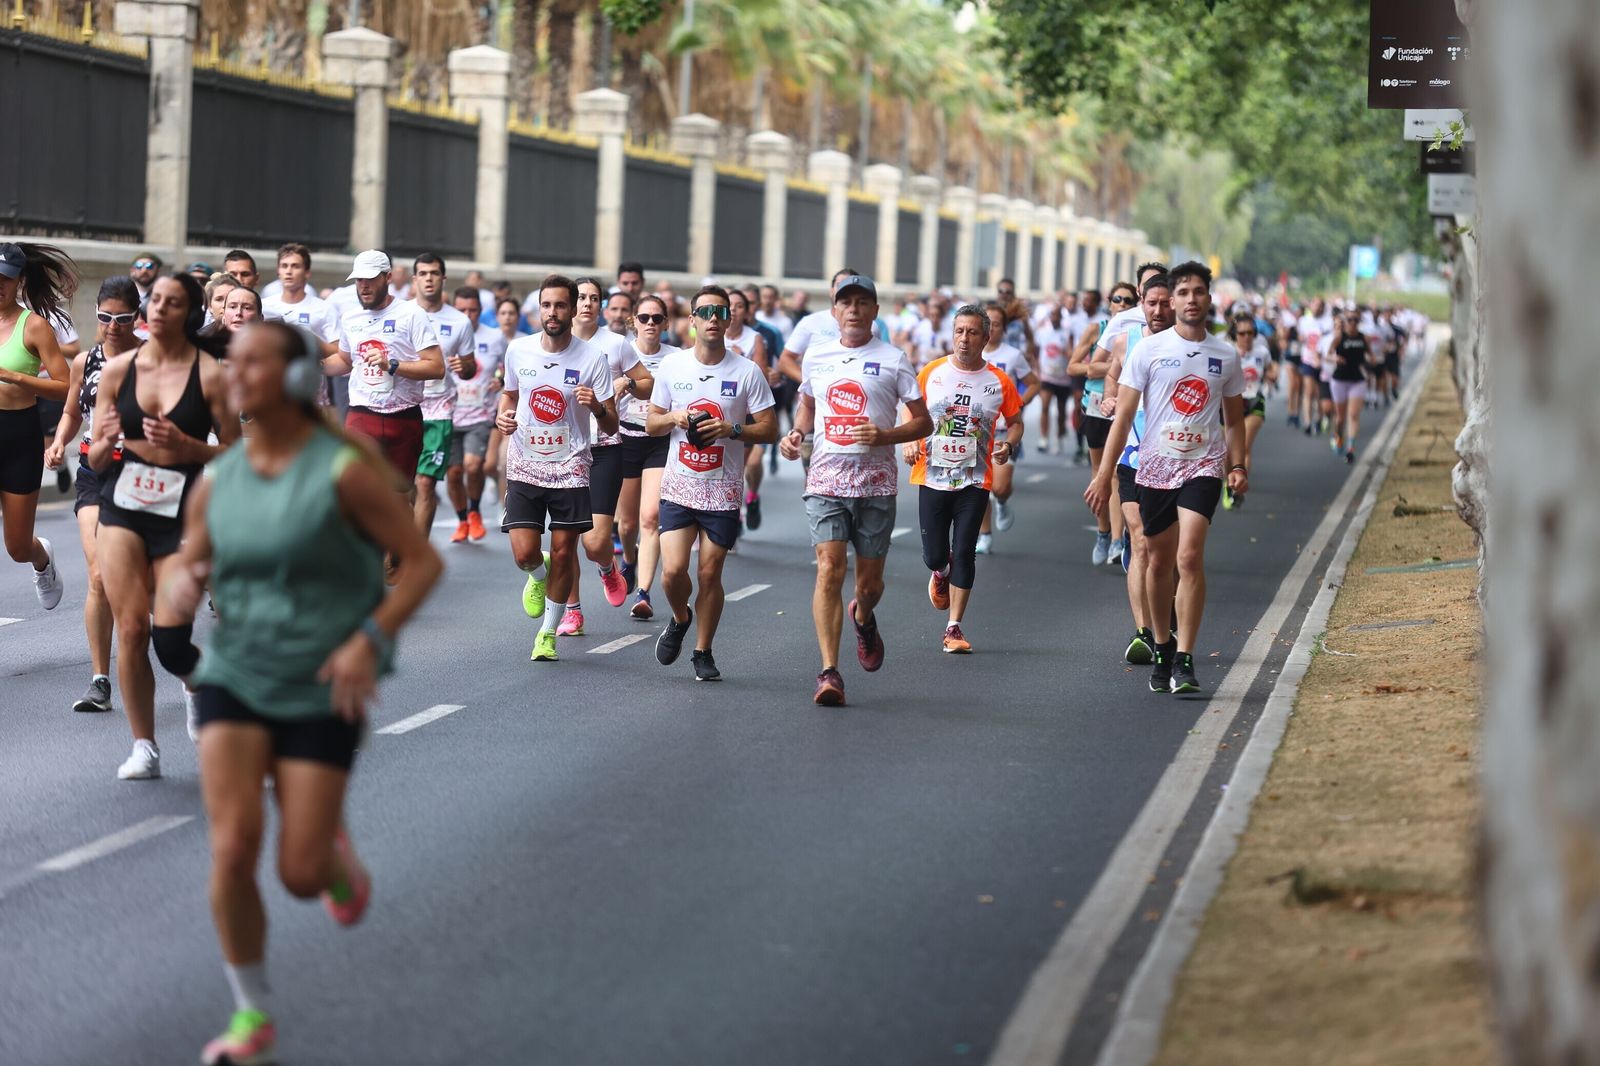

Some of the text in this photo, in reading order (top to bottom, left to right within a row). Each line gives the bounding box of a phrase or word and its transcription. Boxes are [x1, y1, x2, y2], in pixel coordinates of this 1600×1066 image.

[1397, 47, 1433, 55] Fundación
[1397, 54, 1424, 63] Unicaja
[363, 368, 384, 377] 314
[832, 388, 862, 404] PONLE
[1175, 391, 1202, 407] FRENO
[1179, 384, 1205, 401] PONLE
[535, 393, 563, 409] PONLE
[830, 396, 861, 411] FRENO
[953, 393, 971, 406] 20
[532, 401, 561, 416] FRENO
[828, 424, 854, 435] 202
[530, 435, 563, 445] 1314
[1168, 431, 1203, 443] 1274
[942, 444, 967, 454] 416
[683, 449, 718, 463] 2025
[134, 475, 165, 493] 131
